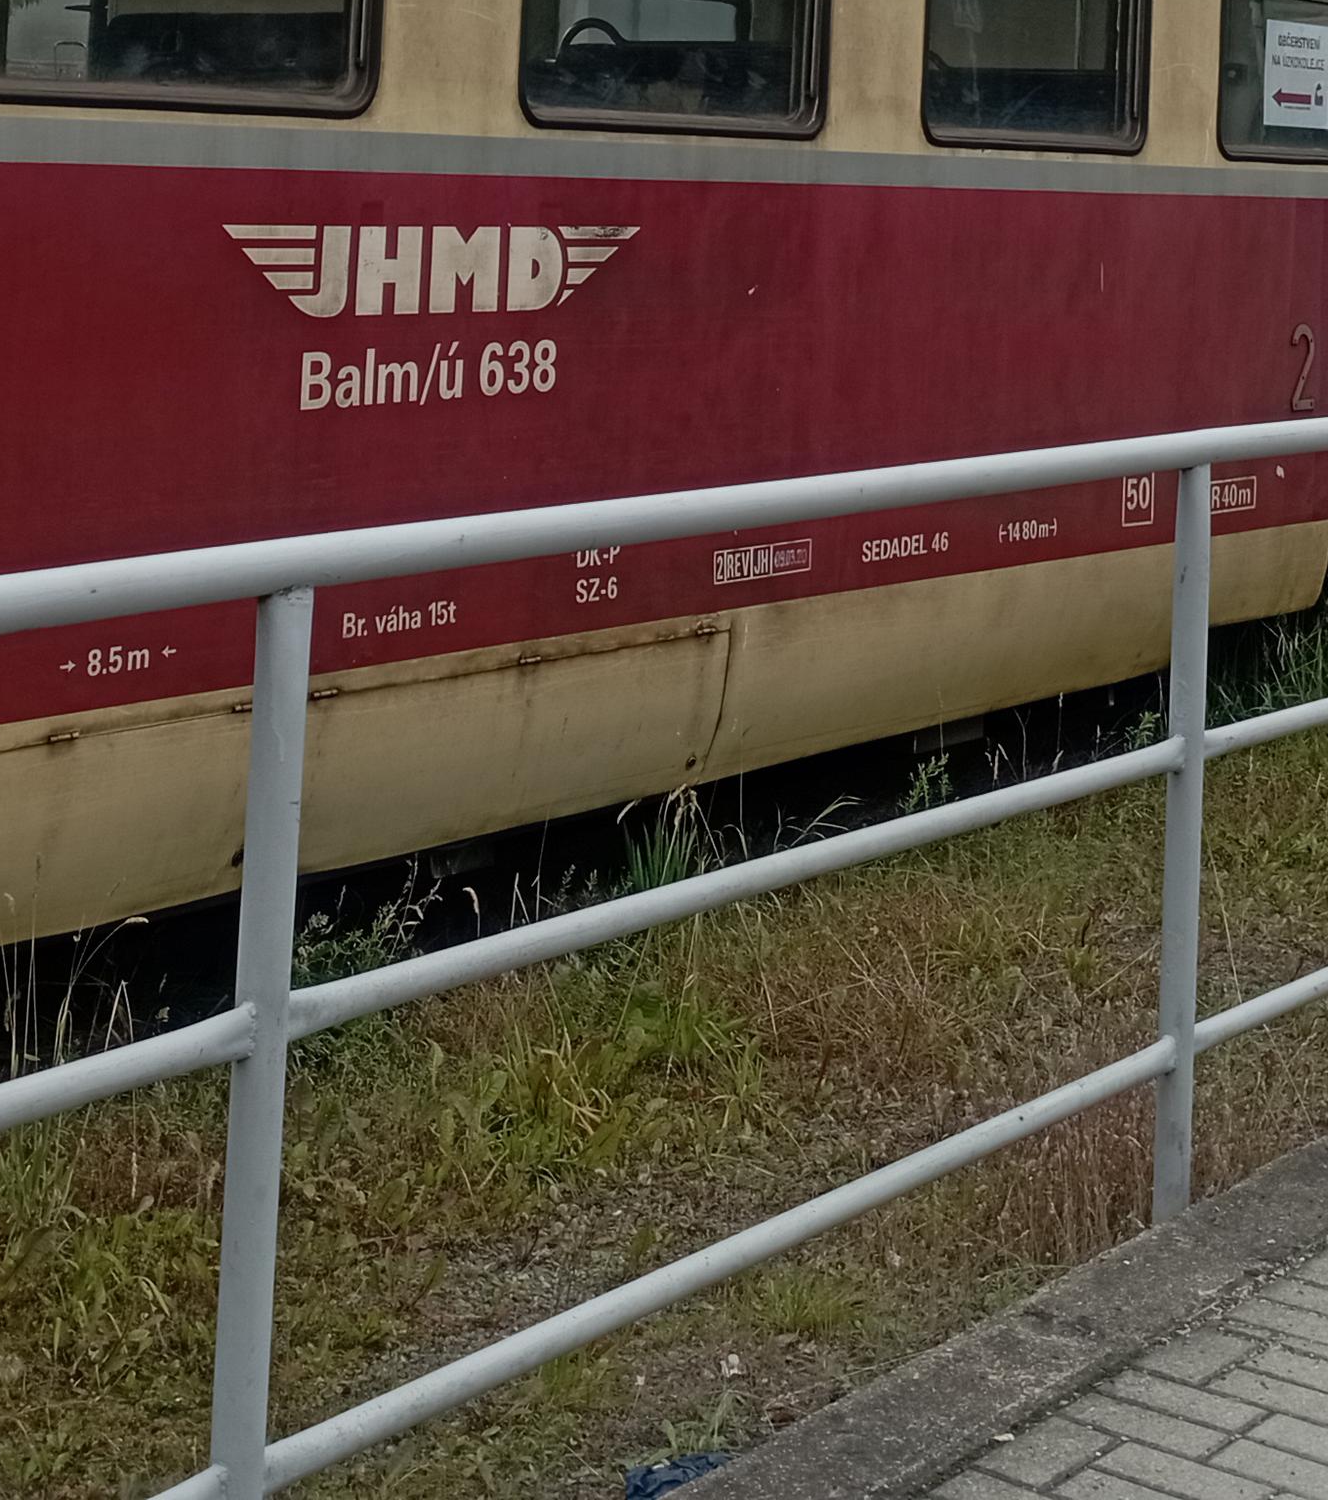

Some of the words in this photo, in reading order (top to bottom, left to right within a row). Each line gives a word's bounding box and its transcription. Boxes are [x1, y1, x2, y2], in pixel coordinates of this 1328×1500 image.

[288, 223, 564, 318] JHMD
[300, 341, 465, 411] Balm/ú
[479, 339, 558, 397] 638
[1291, 323, 1315, 412] 2
[1126, 477, 1150, 511] 50
[716, 555, 724, 580] 2
[727, 551, 750, 578] REV
[754, 549, 769, 574] JH
[861, 535, 928, 563] SEDADEL
[932, 531, 950, 553] 46
[575, 577, 618, 604] SZ-6
[342, 612, 368, 638] Br.
[375, 605, 422, 635] váha
[428, 601, 457, 627] 15t
